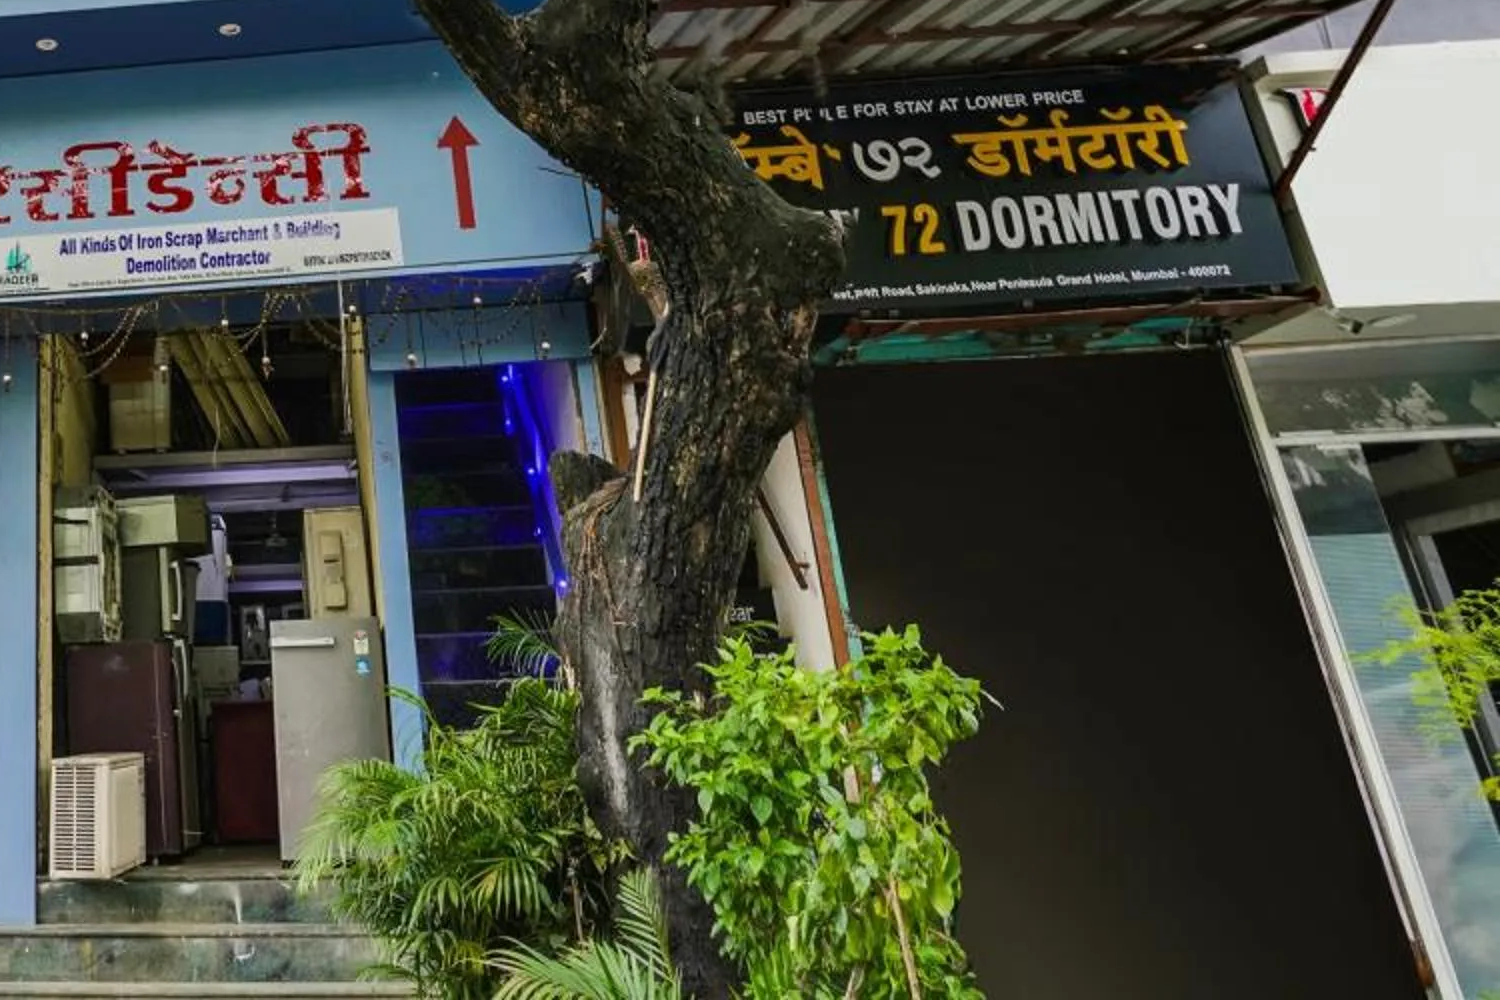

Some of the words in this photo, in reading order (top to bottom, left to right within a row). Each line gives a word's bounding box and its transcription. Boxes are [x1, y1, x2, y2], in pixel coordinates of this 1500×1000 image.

[743, 109, 787, 125] BEST
[853, 102, 889, 119] FOR
[894, 99, 934, 115] STAY
[939, 97, 959, 112] AT
[965, 92, 1029, 111] LOWER
[1032, 89, 1086, 106] PRICE
[853, 136, 942, 182] ७२
[951, 104, 1191, 177] डॉर्मटॉरी
[881, 203, 946, 255] 72
[955, 183, 1244, 252] DORMITORY
[59, 238, 77, 256] All
[80, 236, 117, 255] Kinds
[119, 233, 134, 251] Of
[137, 232, 163, 250] Iron
[165, 230, 203, 249] Scrap
[126, 254, 197, 275] Demolition
[199, 250, 271, 269] Contractor
[1056, 273, 1093, 286] Grand
[1131, 267, 1180, 282] Mumbai
